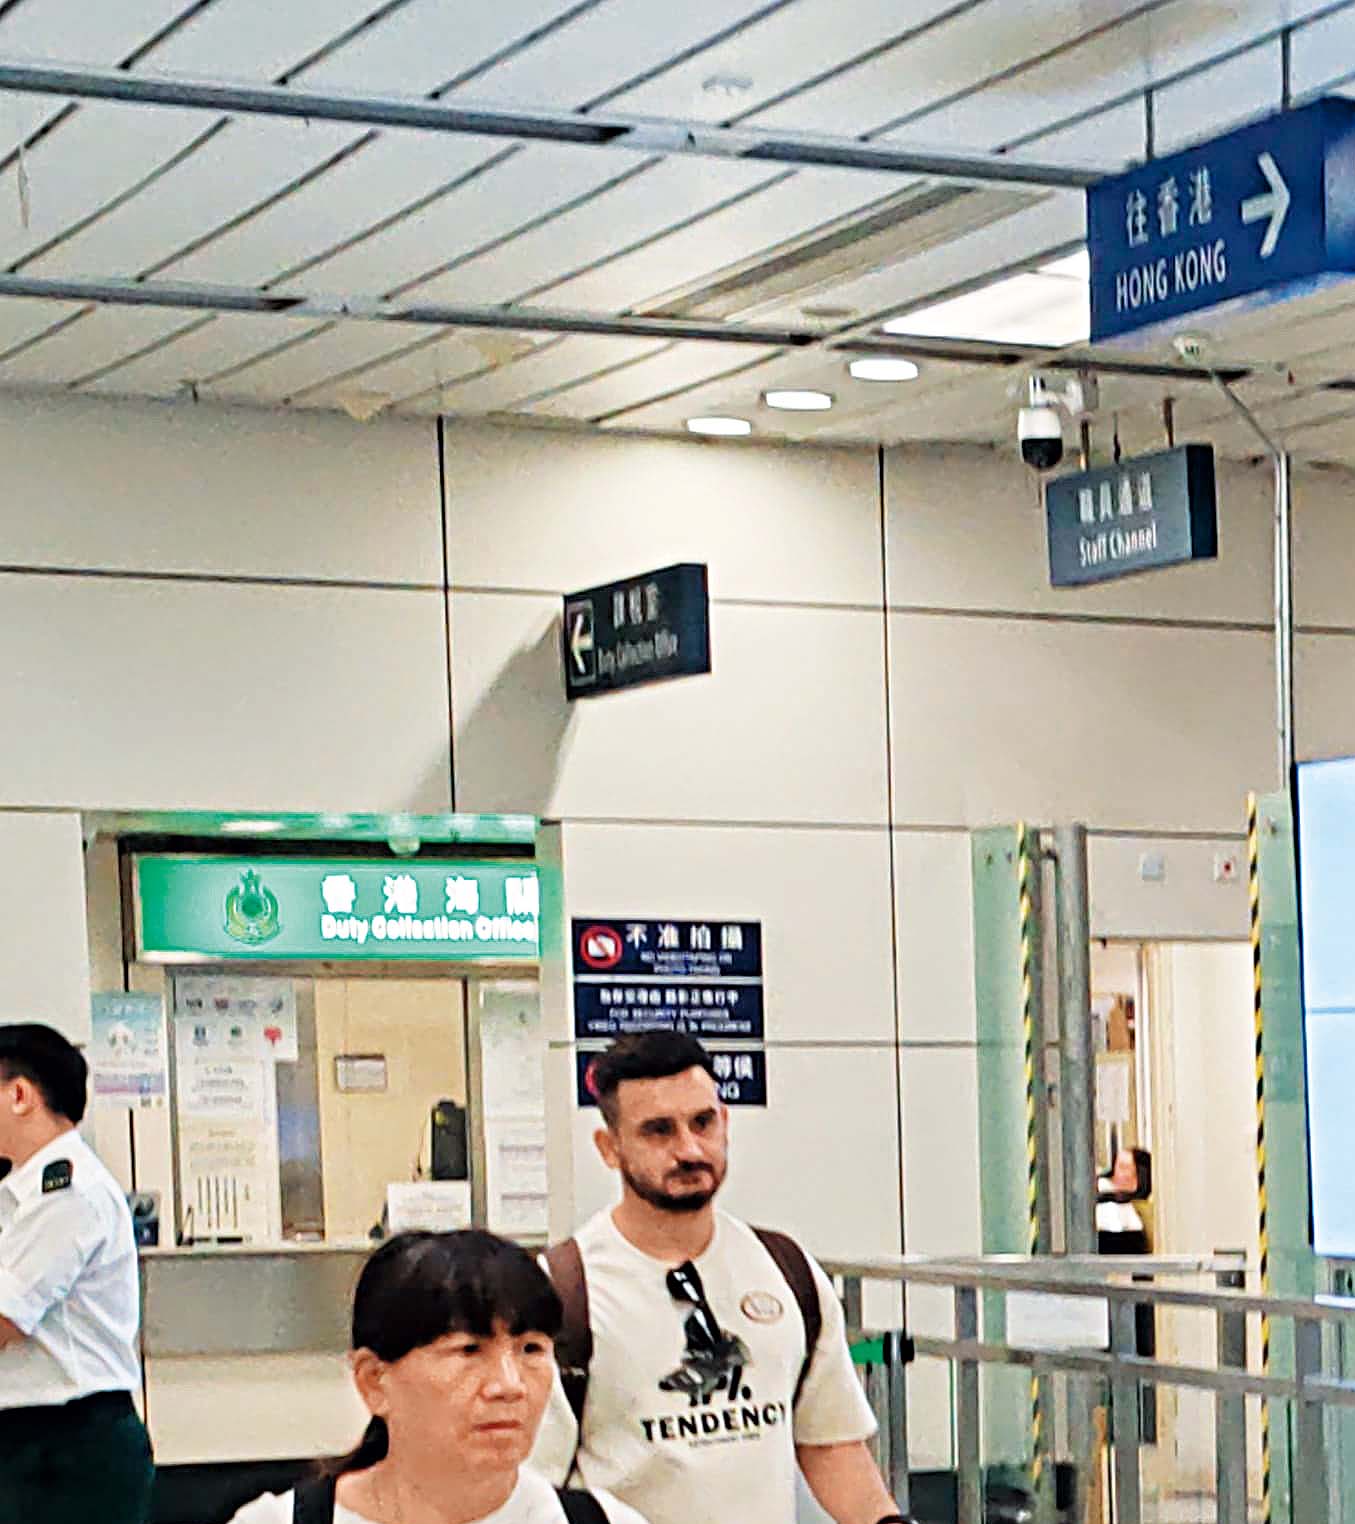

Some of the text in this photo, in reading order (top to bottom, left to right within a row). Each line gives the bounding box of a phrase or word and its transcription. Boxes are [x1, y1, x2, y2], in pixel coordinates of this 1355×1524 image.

[1116, 238, 1227, 312] HONG KONG
[1079, 519, 1157, 568] Staff Channel
[321, 914, 368, 944] Duty
